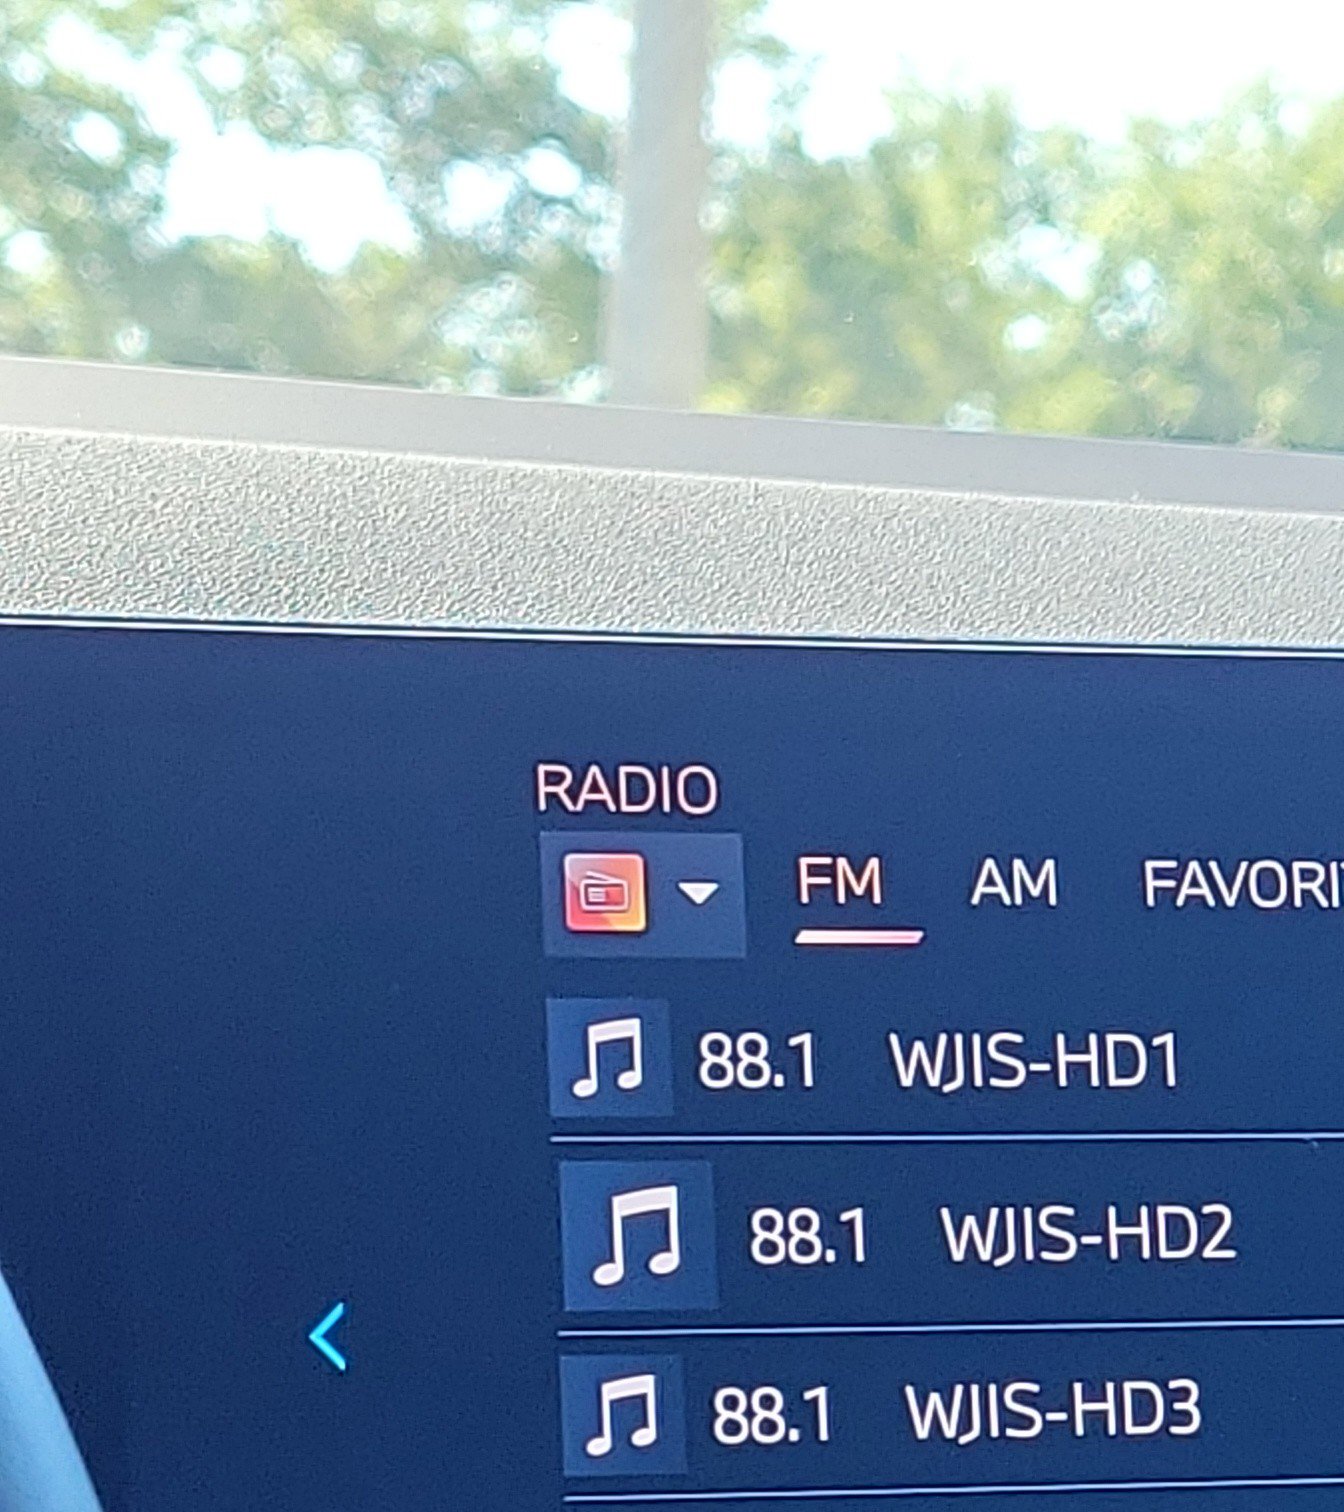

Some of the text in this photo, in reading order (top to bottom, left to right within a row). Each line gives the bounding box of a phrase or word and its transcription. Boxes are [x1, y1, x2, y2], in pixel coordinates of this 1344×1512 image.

[536, 763, 719, 814] RADIO
[798, 856, 883, 906] FM
[970, 857, 1058, 907] AM
[699, 1031, 1179, 1094] 88.1 WJIS-HD1
[749, 1203, 1238, 1267] 88.1 WJIS-HD2
[712, 1378, 1202, 1446] 88.1 WJIS-HD3
